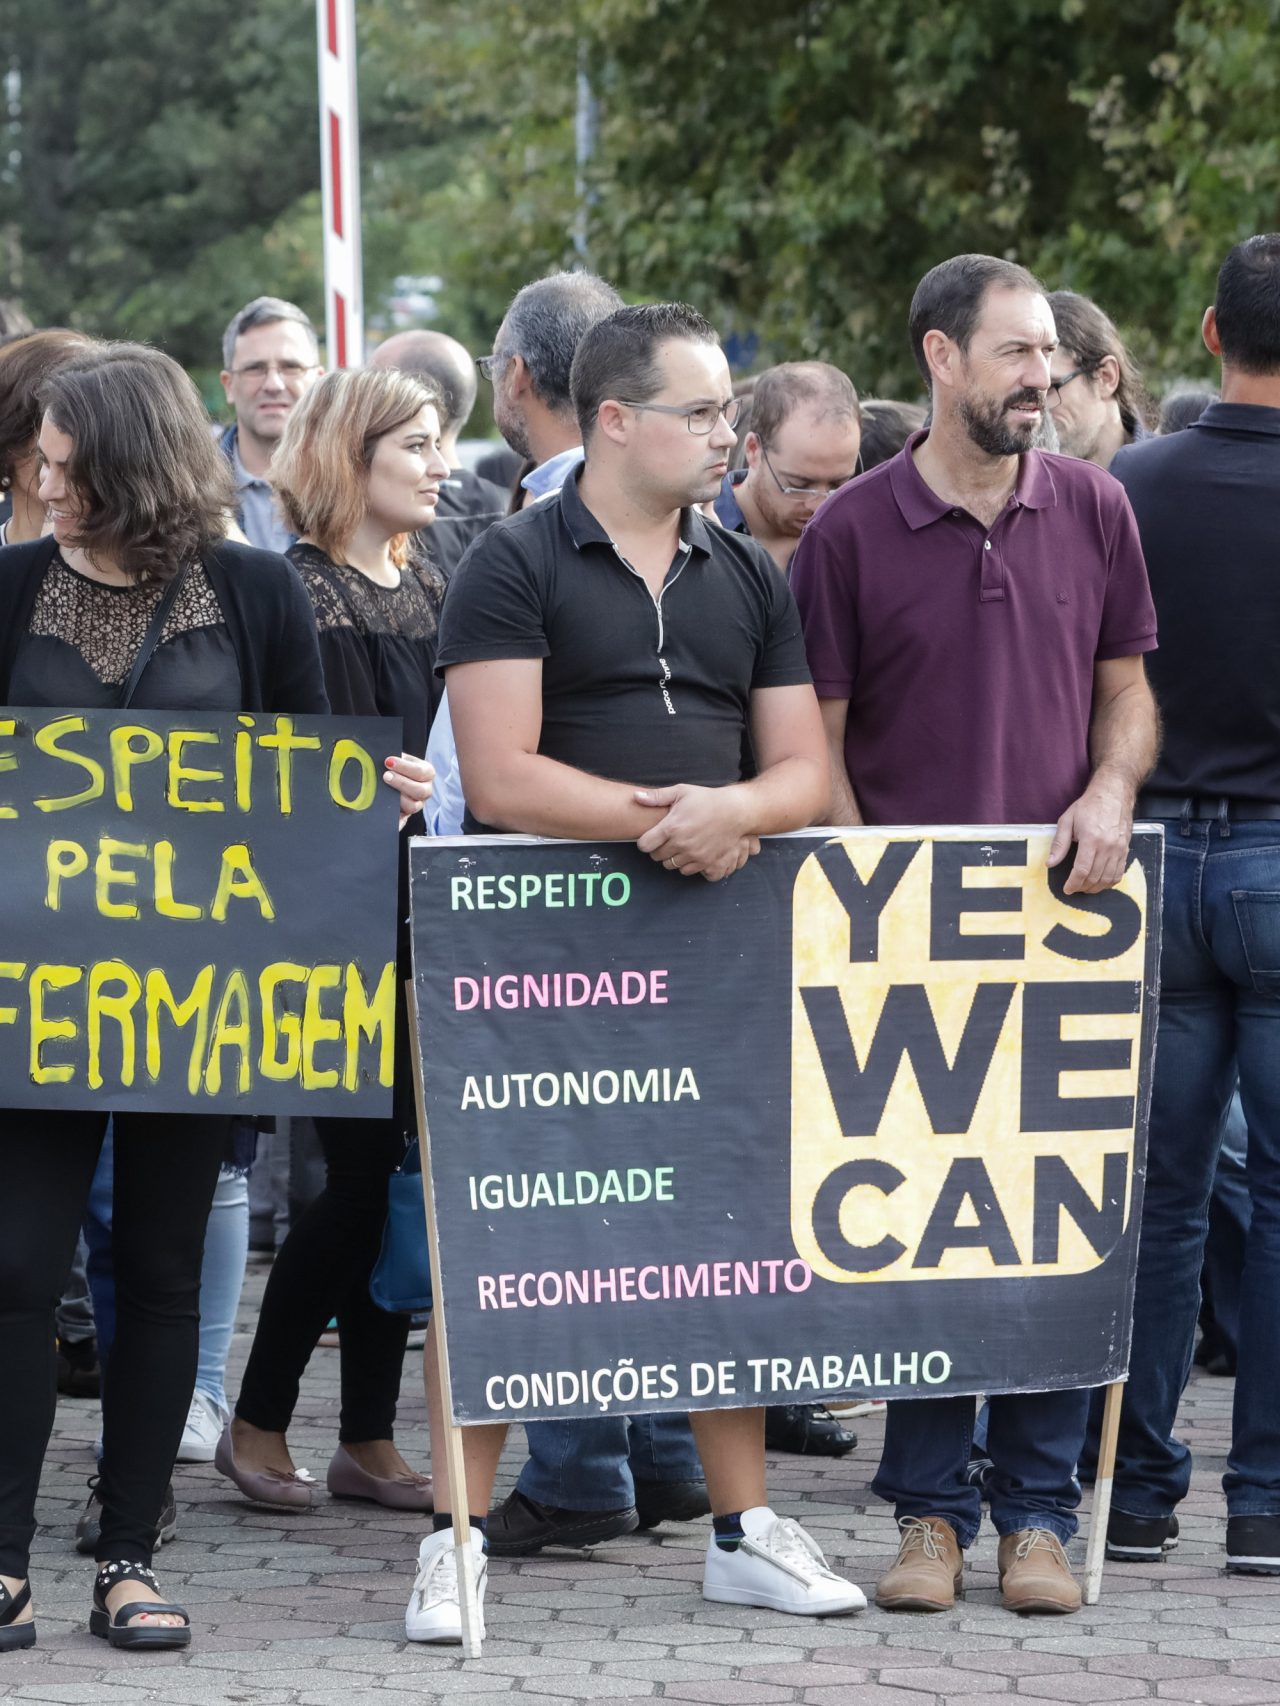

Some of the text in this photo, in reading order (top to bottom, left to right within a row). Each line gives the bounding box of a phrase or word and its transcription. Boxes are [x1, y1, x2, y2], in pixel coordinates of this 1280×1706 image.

[45, 837, 276, 921] PELA
[450, 872, 632, 911] RESPEITO
[812, 838, 1142, 963] YES
[453, 969, 669, 1011] DIGNIDADE
[798, 980, 1142, 1138] WE
[460, 1066, 701, 1111] AUTONOMIA
[468, 1166, 675, 1211] IGUALDADE
[811, 1151, 1129, 1274] CAN
[477, 1258, 813, 1311] RECONHECIMENTO
[485, 1350, 951, 1412] CONDIÇÕES DE TRABALHO
